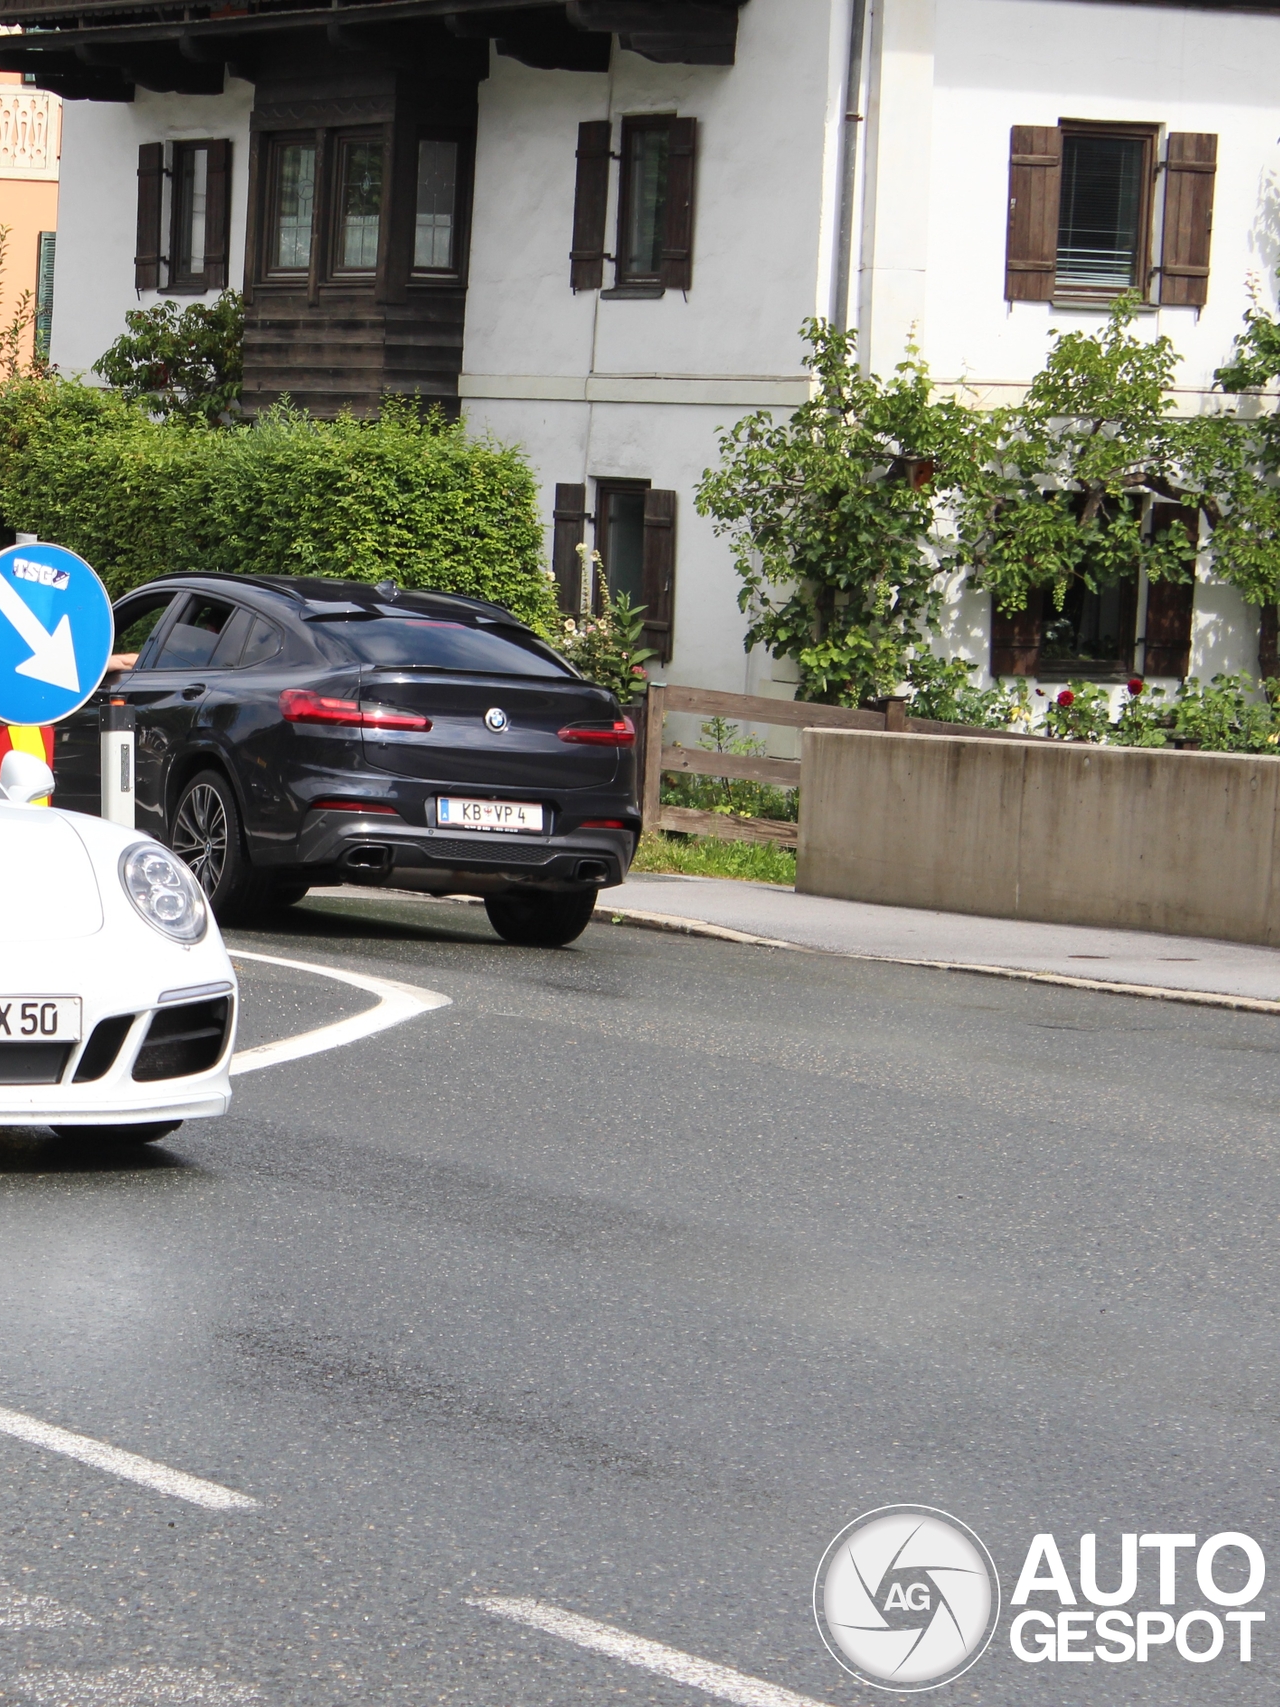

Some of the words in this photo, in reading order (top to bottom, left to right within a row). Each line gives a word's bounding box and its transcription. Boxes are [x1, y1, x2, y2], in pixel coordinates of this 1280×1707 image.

[462, 803, 481, 821] KB
[494, 805, 513, 823] VP
[517, 807, 526, 824] 4
